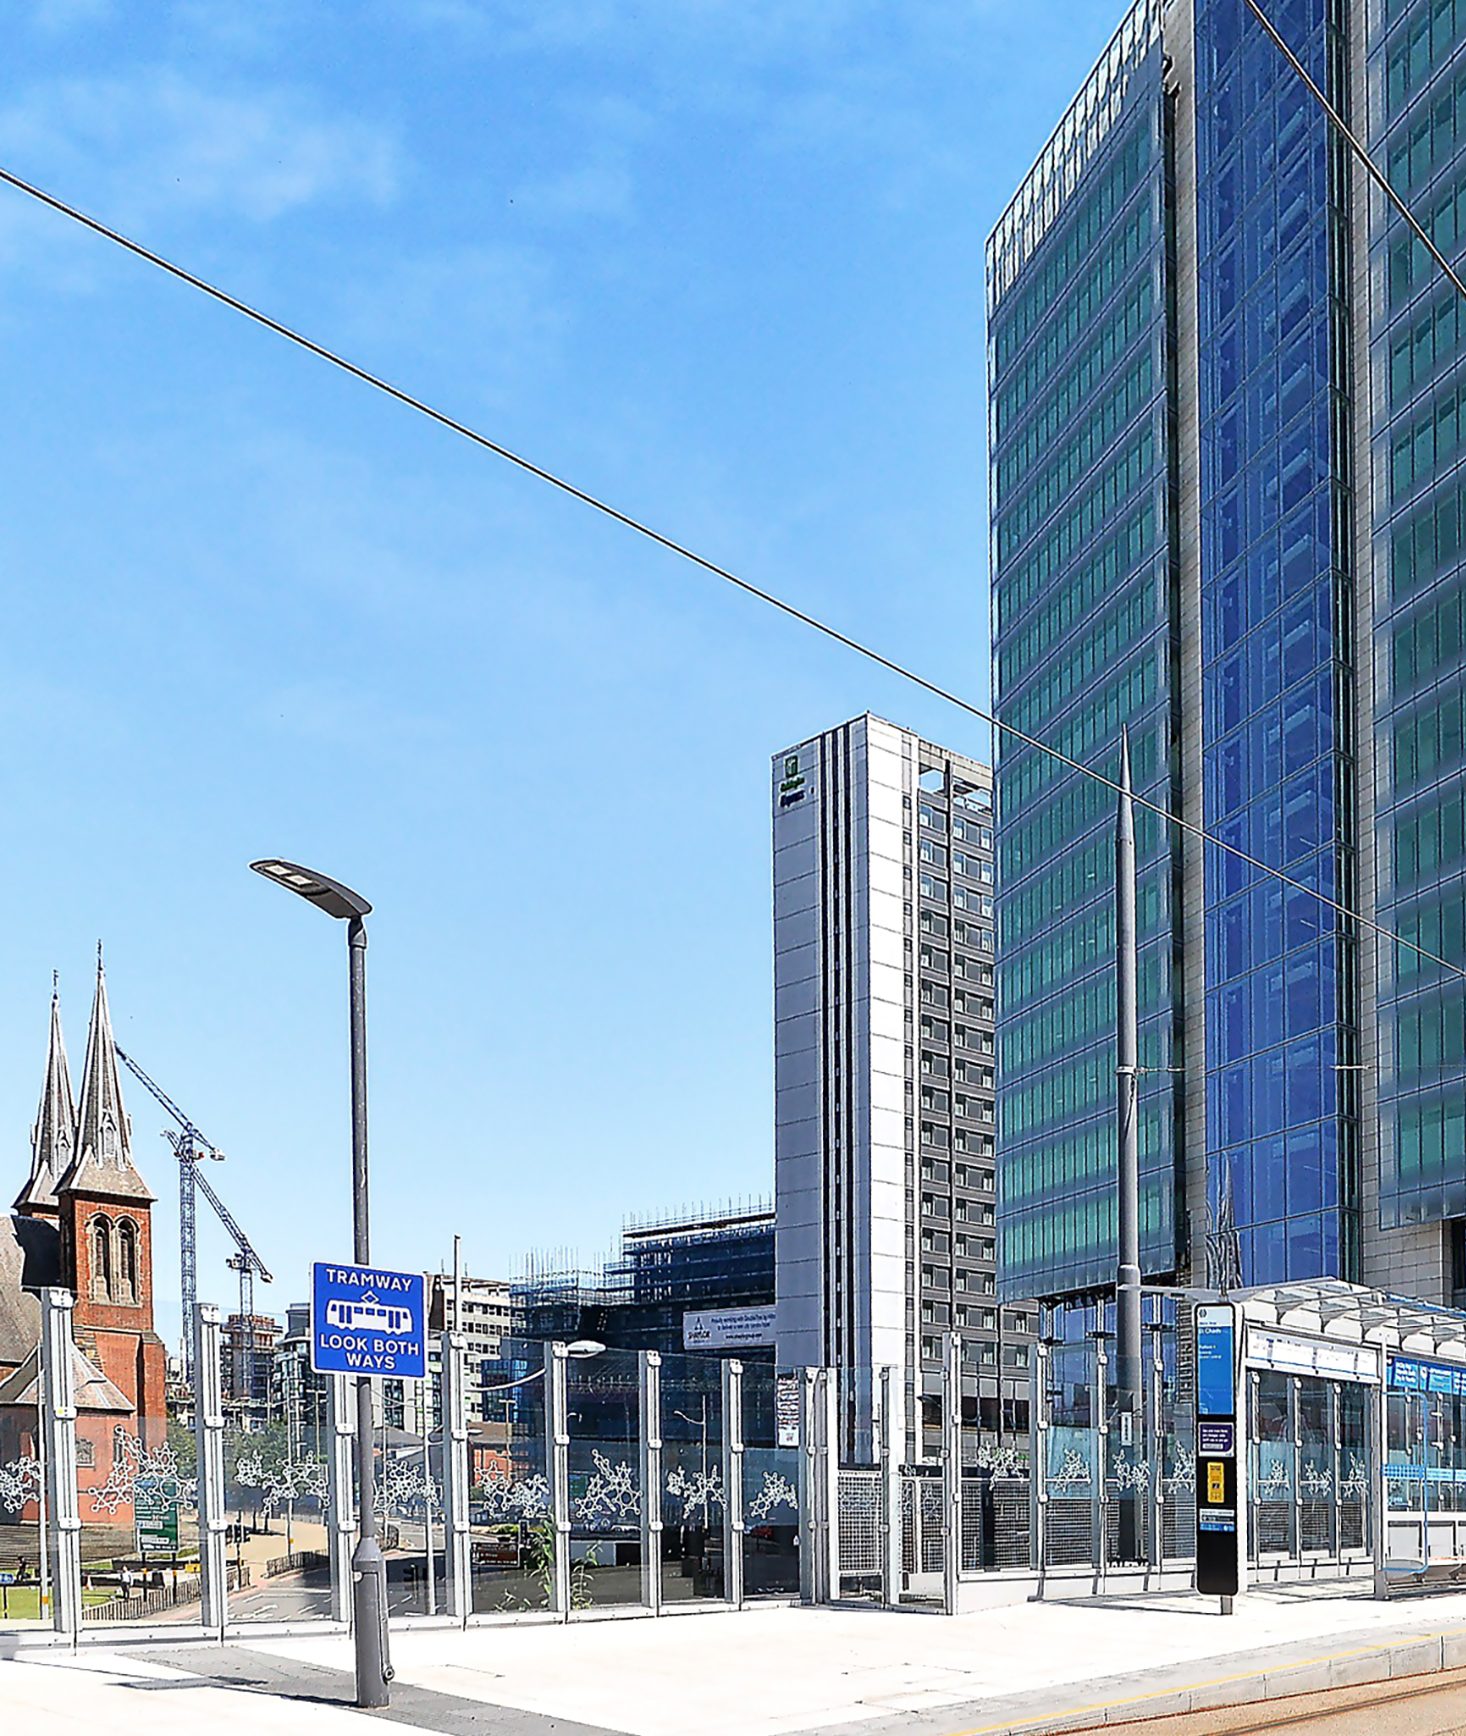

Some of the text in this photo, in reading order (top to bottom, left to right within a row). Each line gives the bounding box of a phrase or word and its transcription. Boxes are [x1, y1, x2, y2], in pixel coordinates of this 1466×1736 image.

[326, 1268, 413, 1292] TRAMWAY
[320, 1334, 419, 1356] LOOK BOTH
[346, 1352, 396, 1369] WAYS
